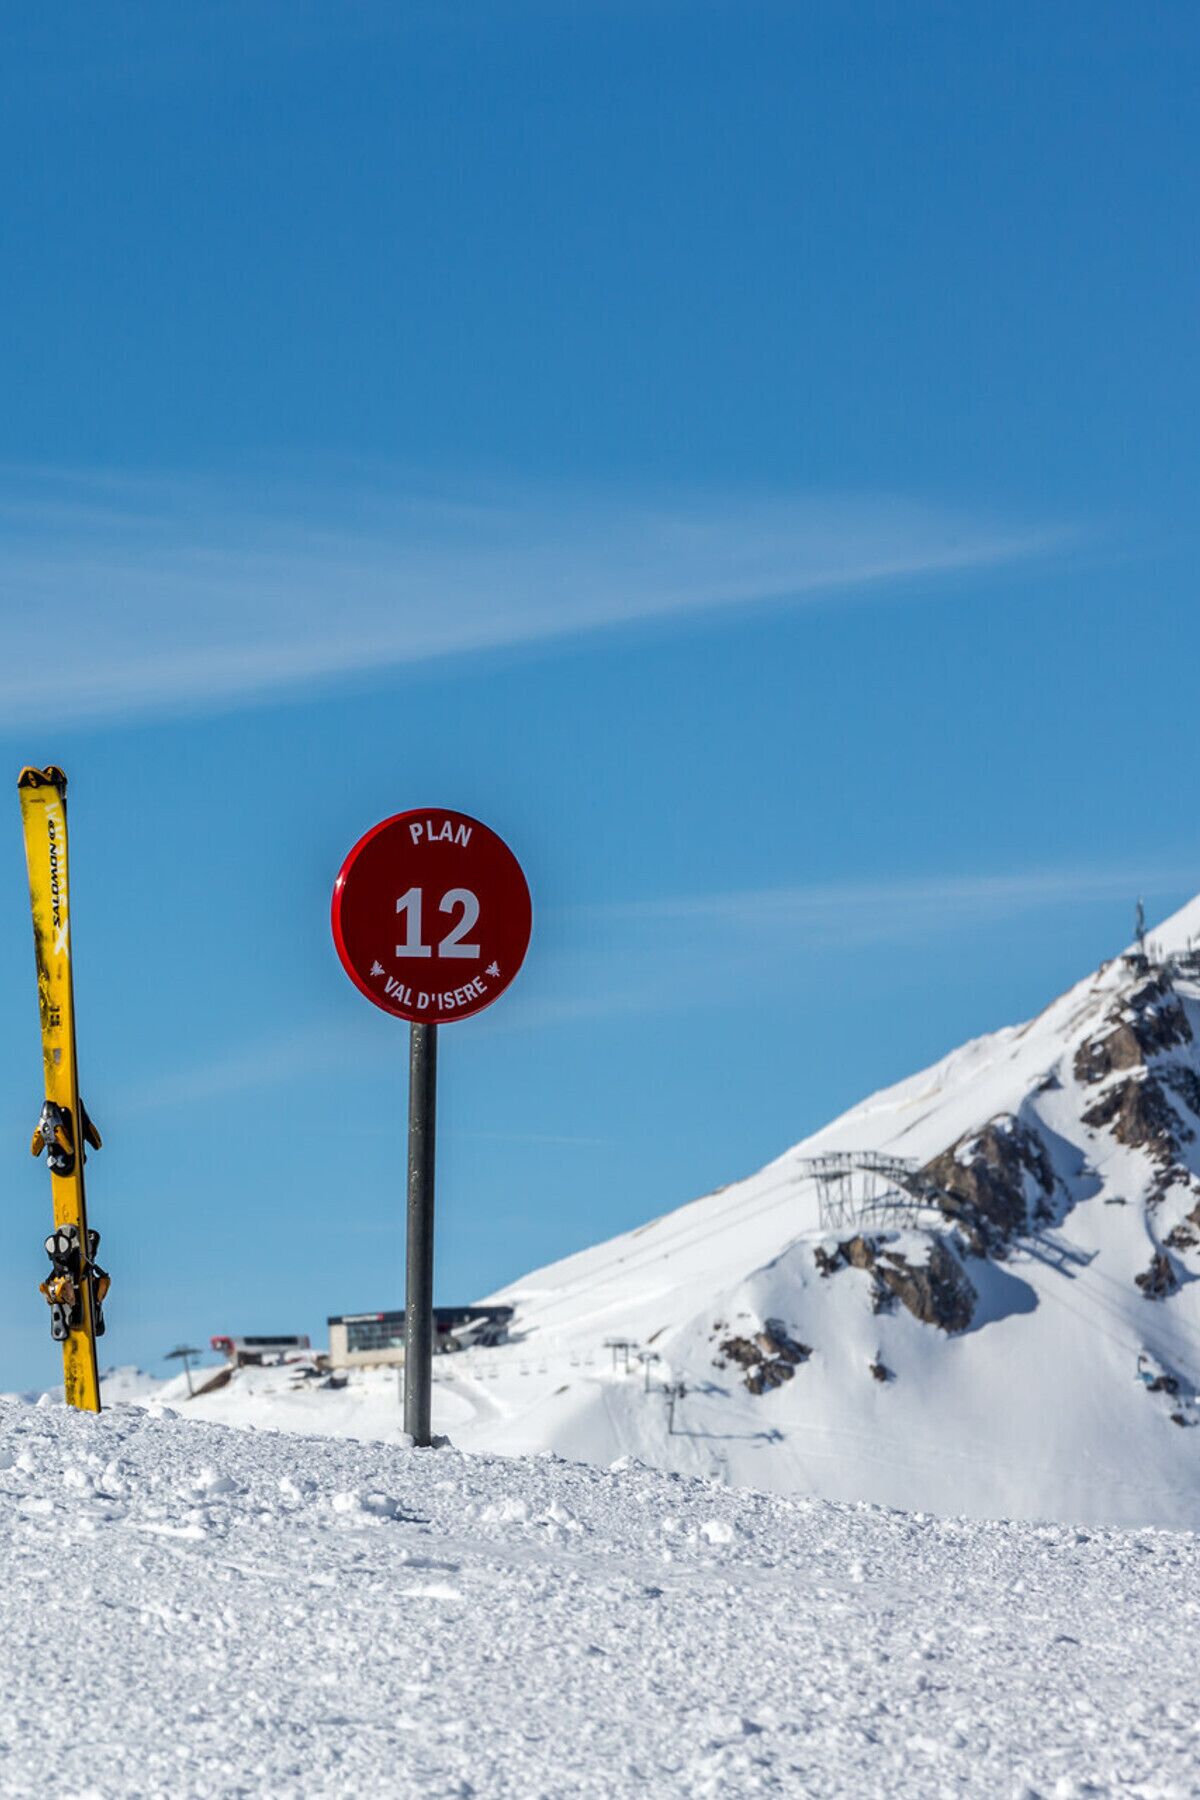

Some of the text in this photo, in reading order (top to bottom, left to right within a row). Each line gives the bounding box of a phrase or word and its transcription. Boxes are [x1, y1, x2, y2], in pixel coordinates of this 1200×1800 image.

[409, 820, 473, 848] PLAN
[49, 844, 61, 928] SALOMON
[395, 887, 481, 959] 12
[384, 976, 487, 1010] VAL D'ISERE
